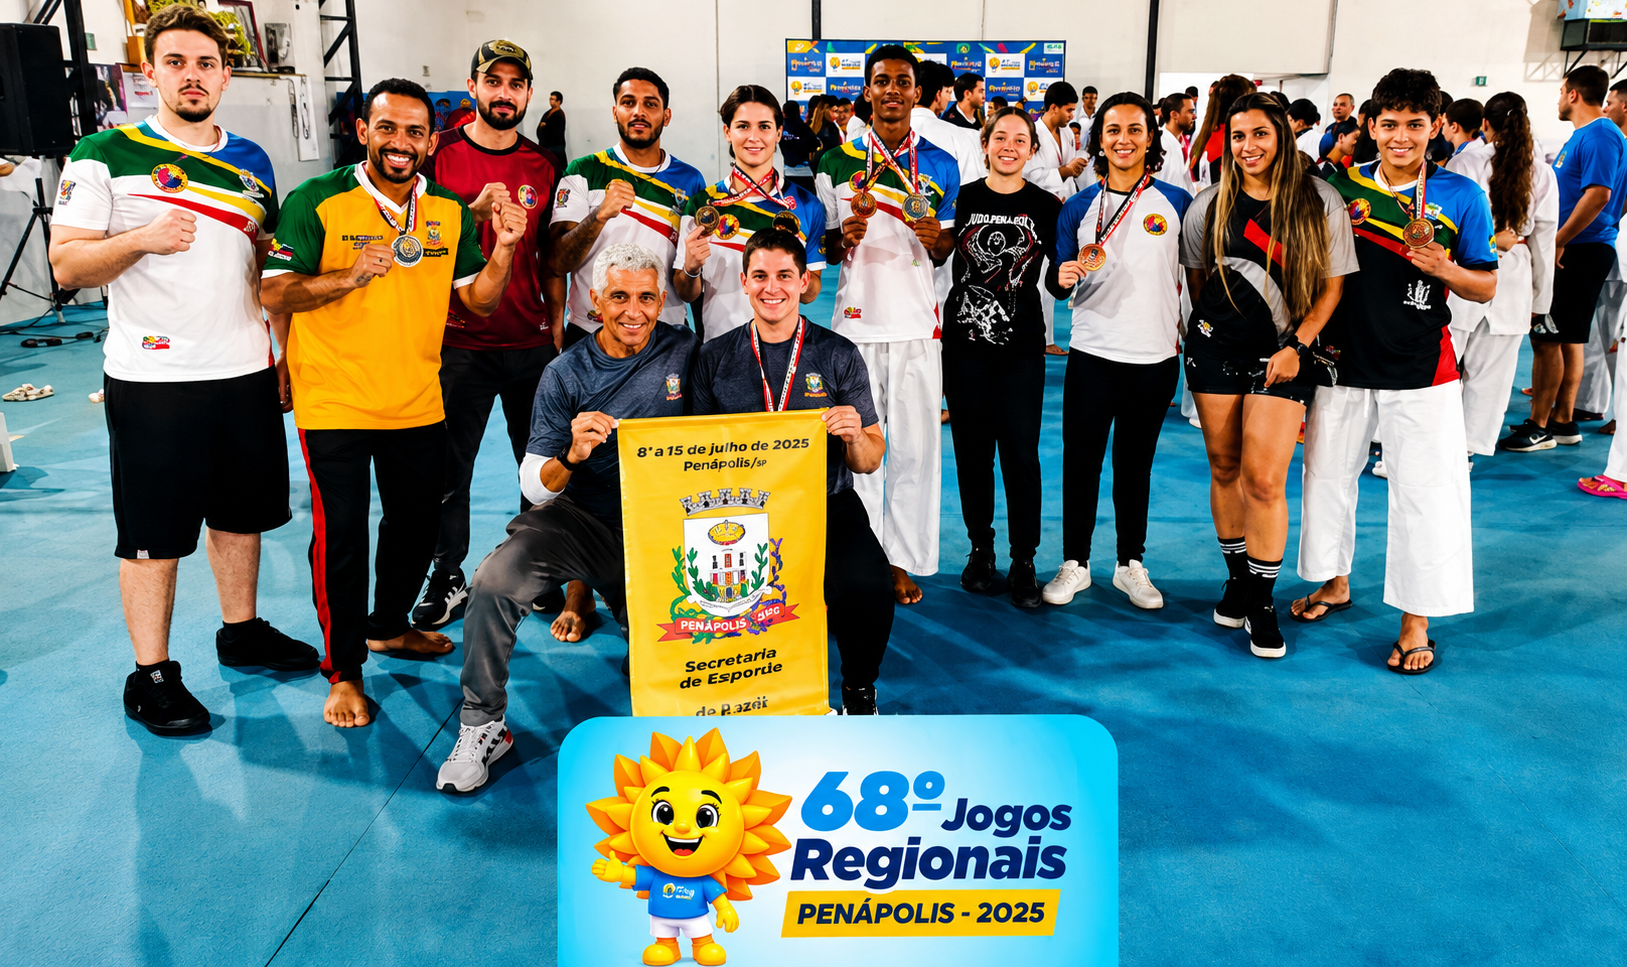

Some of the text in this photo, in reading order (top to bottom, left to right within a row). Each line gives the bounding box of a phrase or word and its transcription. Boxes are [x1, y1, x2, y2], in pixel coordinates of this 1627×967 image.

[654, 448, 664, 457] a
[667, 445, 684, 456] 15
[687, 444, 707, 456] de
[708, 441, 748, 456] julho
[750, 439, 769, 451] de
[772, 438, 810, 450] 2025
[685, 648, 777, 672] Secretaria
[679, 676, 702, 689] de
